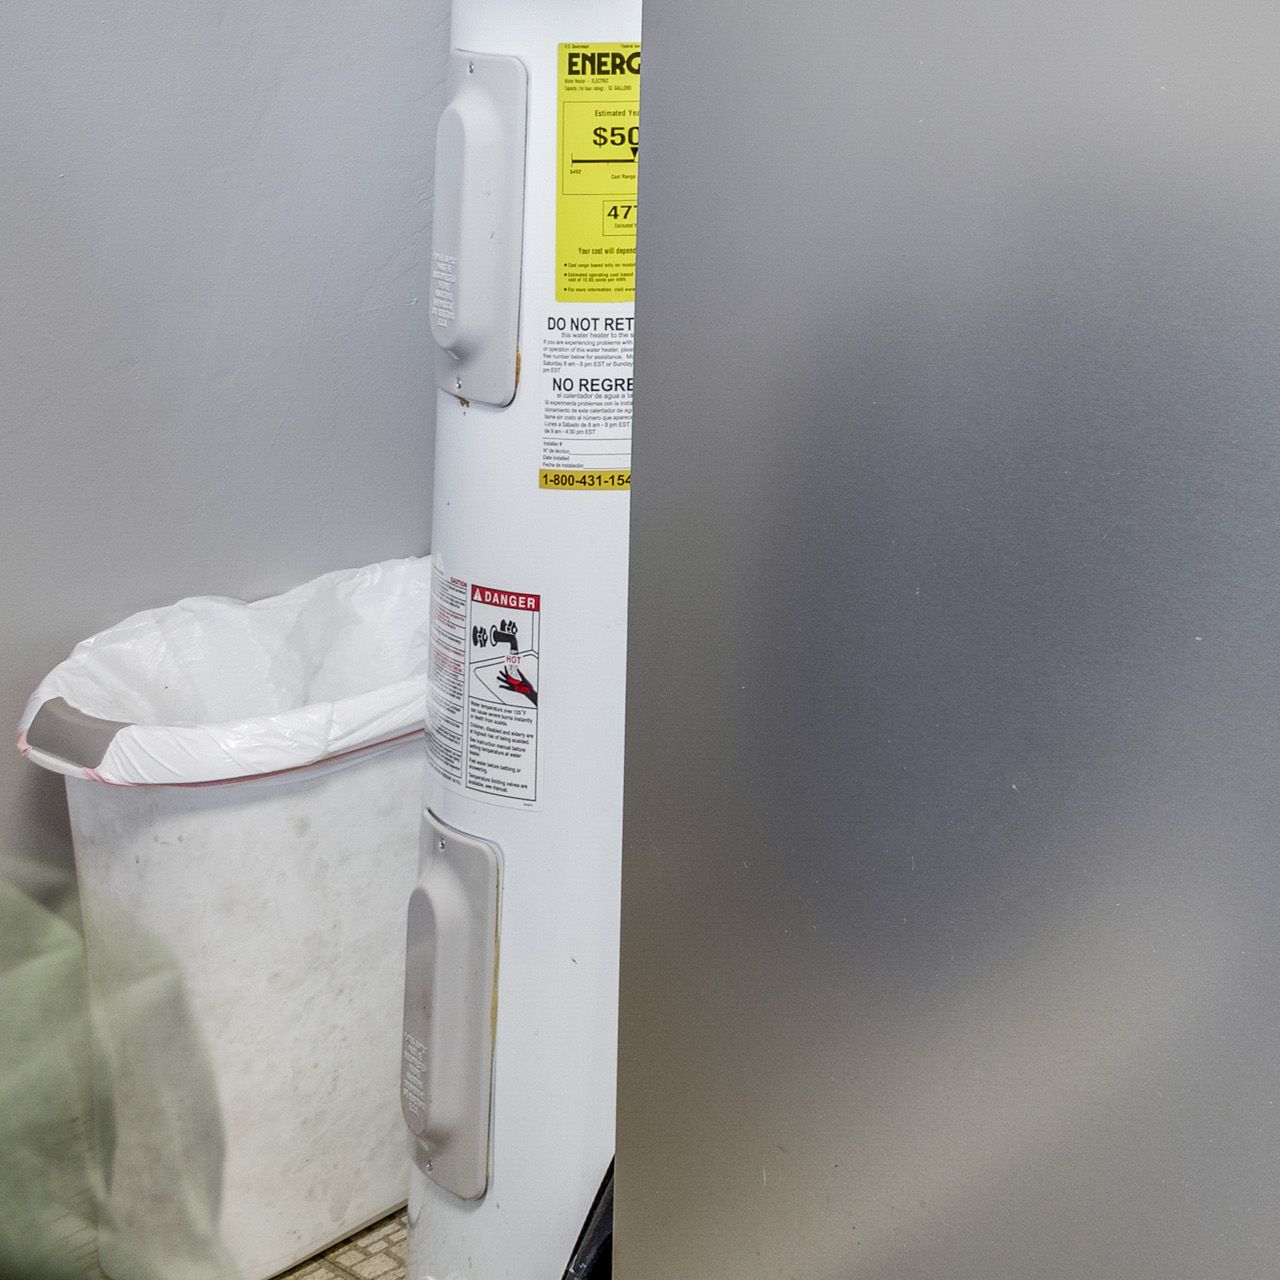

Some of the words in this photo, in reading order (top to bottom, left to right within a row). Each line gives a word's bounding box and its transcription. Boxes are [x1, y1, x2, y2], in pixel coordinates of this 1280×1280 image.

[568, 52, 640, 75] ENERG
[548, 317, 566, 331] DO
[570, 317, 600, 331] NOT
[553, 378, 573, 391] NO
[484, 590, 536, 609] DANGER
[506, 655, 521, 664] HOT
